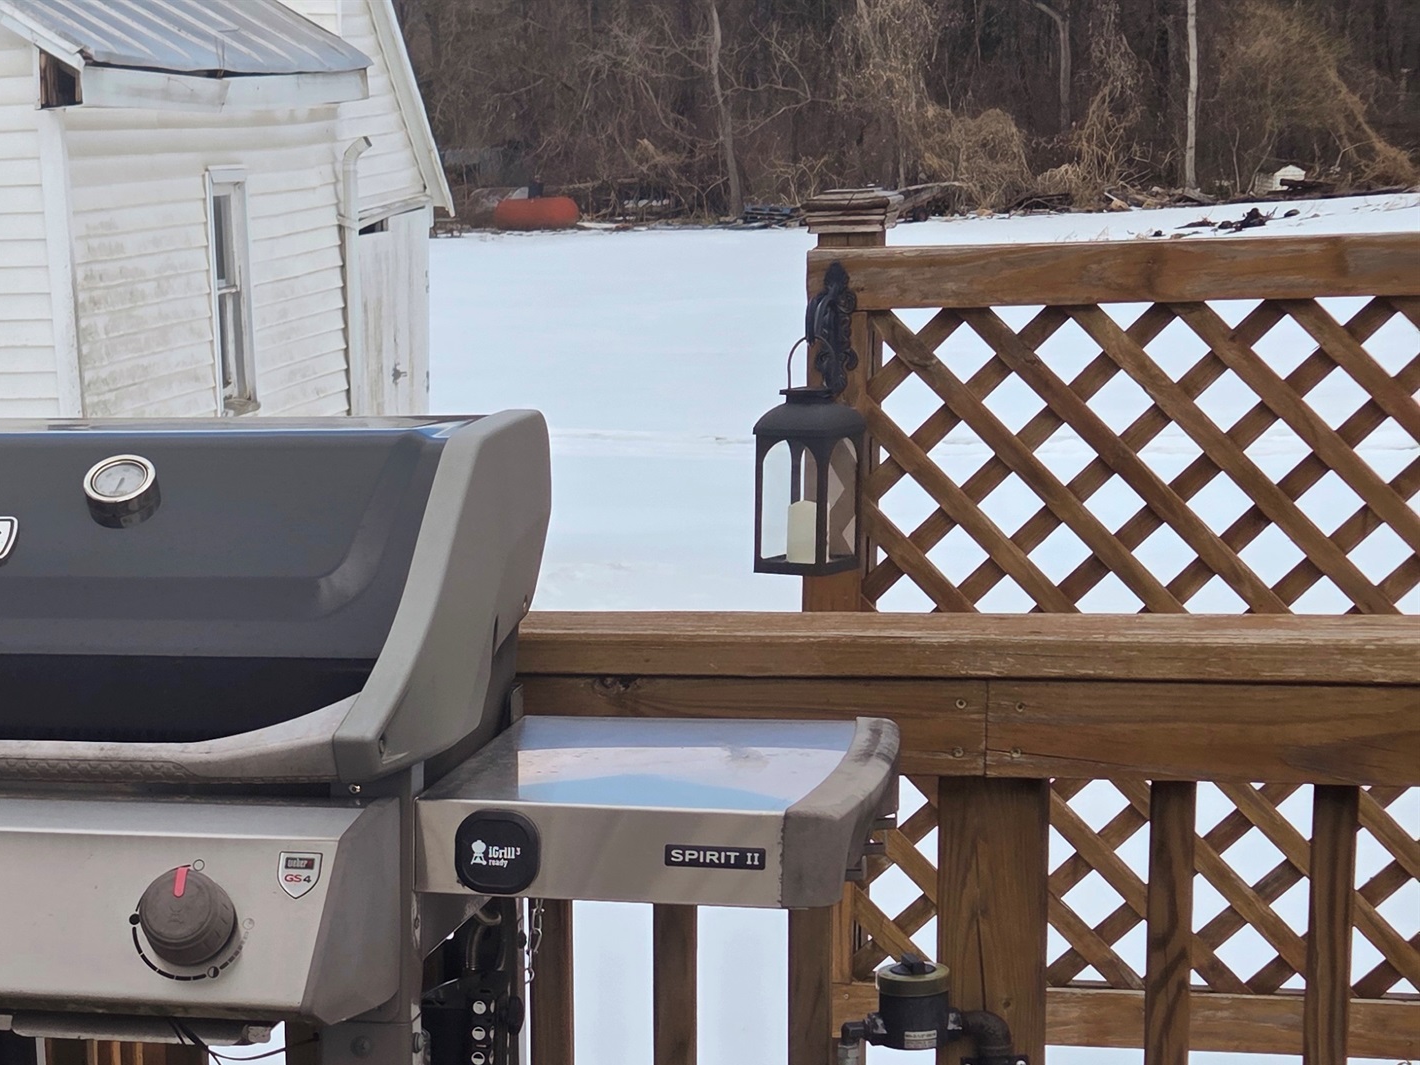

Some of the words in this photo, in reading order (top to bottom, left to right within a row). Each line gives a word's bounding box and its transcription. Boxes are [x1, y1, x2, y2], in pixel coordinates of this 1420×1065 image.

[670, 849, 740, 864] SPIRIT
[746, 852, 760, 865] II
[488, 859, 508, 868] ready
